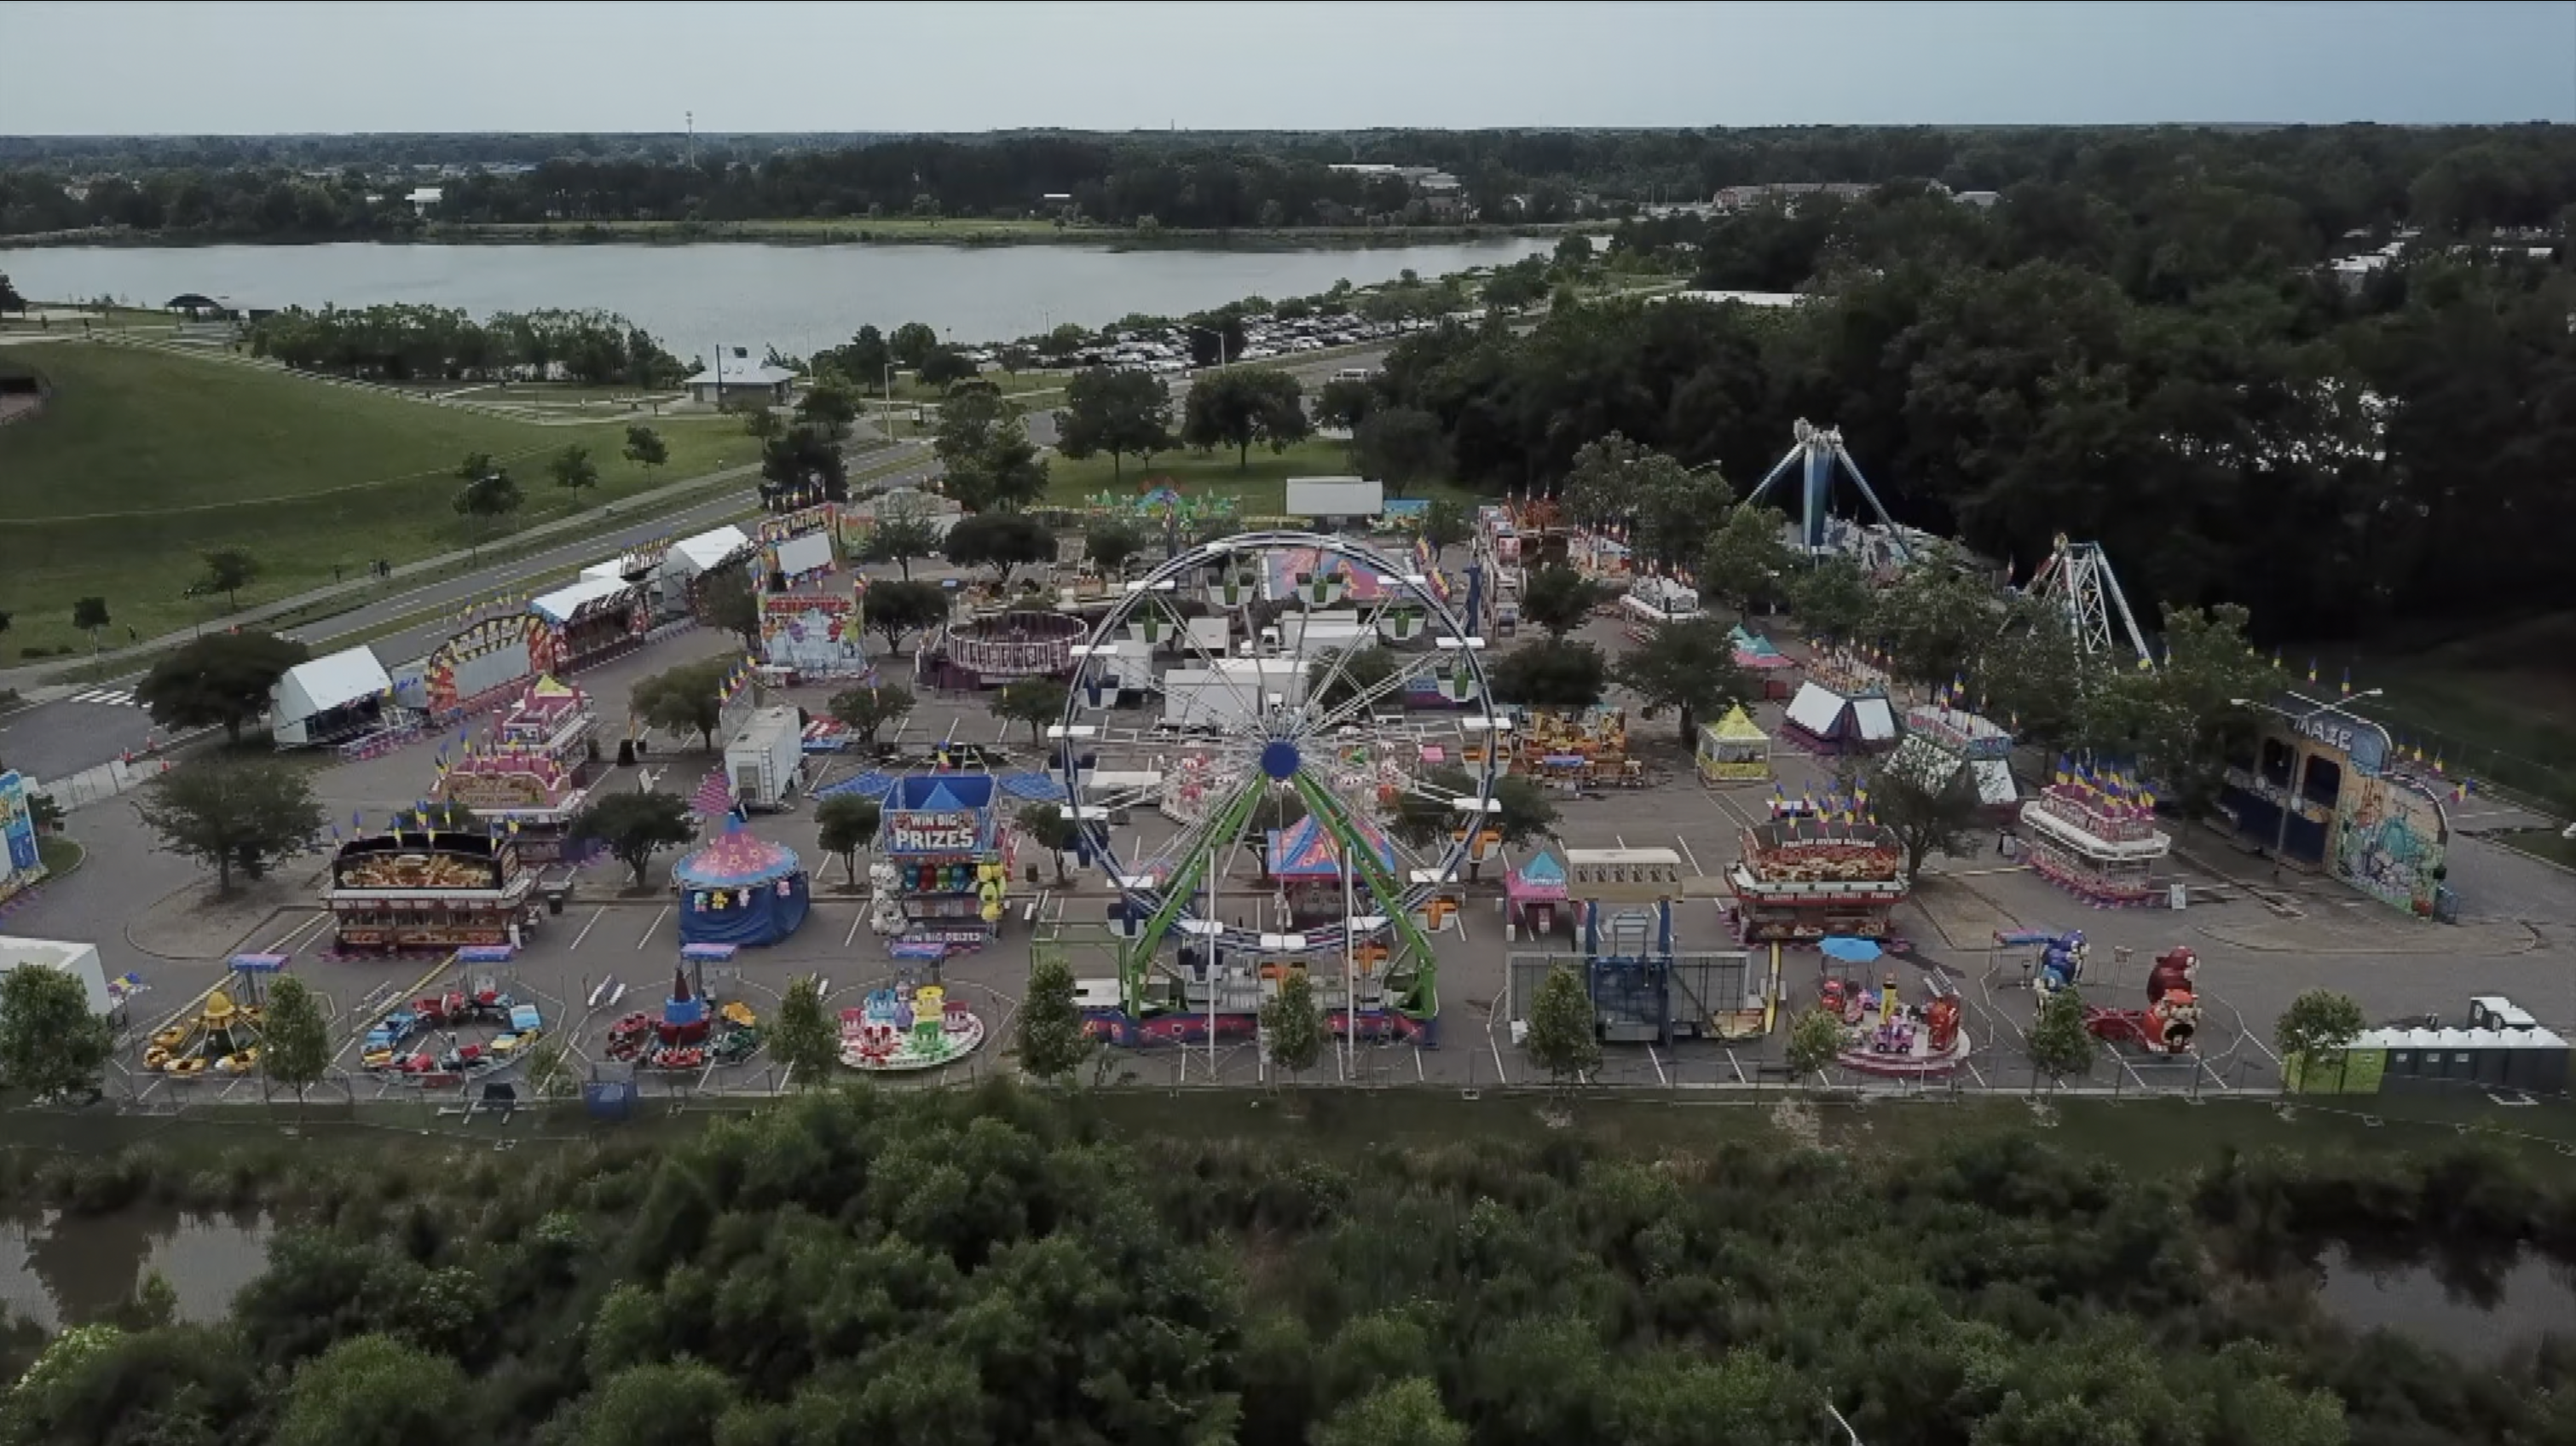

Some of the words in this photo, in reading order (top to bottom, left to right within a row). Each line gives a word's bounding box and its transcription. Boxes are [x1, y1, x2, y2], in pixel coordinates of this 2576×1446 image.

[2293, 716, 2353, 751] MAZE
[910, 813, 934, 826] WIN
[938, 813, 958, 826] BIG
[895, 827, 973, 851] PRIZES
